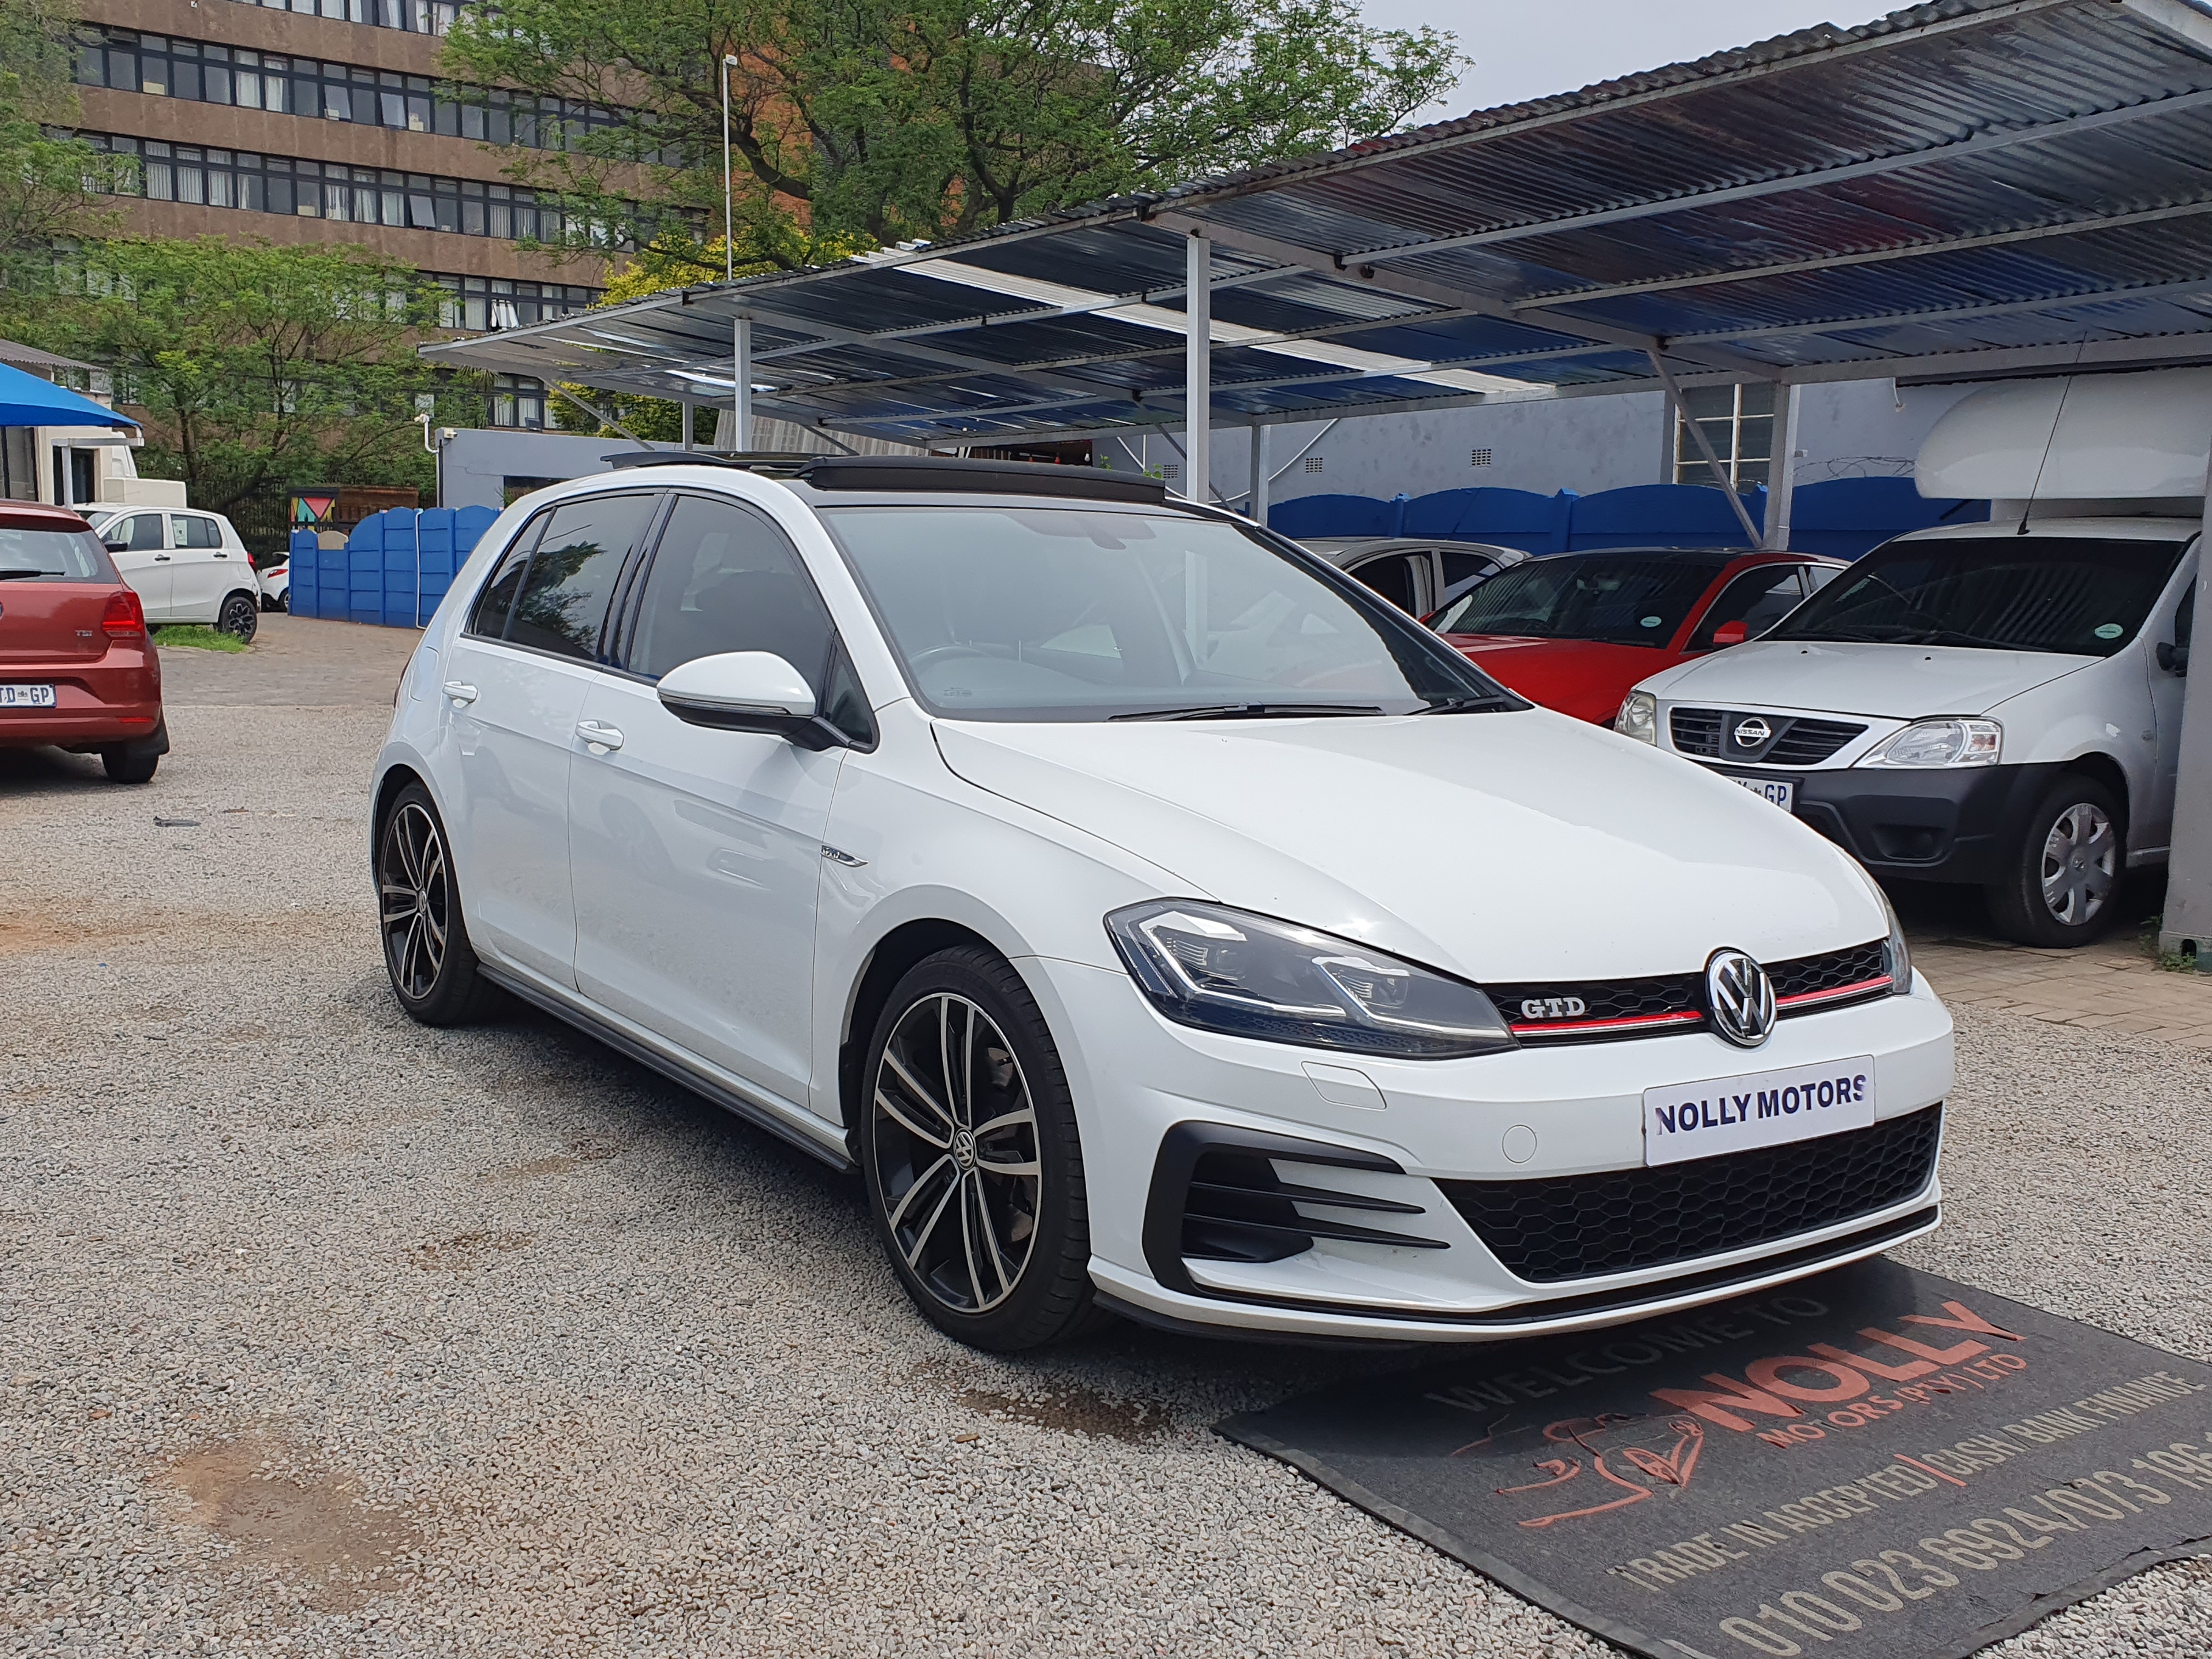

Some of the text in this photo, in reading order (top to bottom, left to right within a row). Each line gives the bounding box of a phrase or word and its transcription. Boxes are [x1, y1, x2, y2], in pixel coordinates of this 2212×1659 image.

[30, 687, 49, 703] GP
[1521, 997, 1585, 1019] GTD
[1655, 1075, 1866, 1135] NOLLY MOTORS
[1424, 1296, 1829, 1413] WELCOME TO
[1650, 1301, 2027, 1432] NOLLY
[1756, 1395, 1903, 1449] MOTORS
[1962, 1354, 2027, 1380] LTD
[1605, 1532, 1750, 1592] TRADE
[1720, 1520, 1788, 1548] IN
[1762, 1464, 1938, 1533] ACCEPTED
[2073, 1371, 2207, 1420] FINANCE
[1719, 1591, 1863, 1657] 010
[1821, 1550, 1960, 1612] 023
[2130, 1432, 2212, 1490] 196
